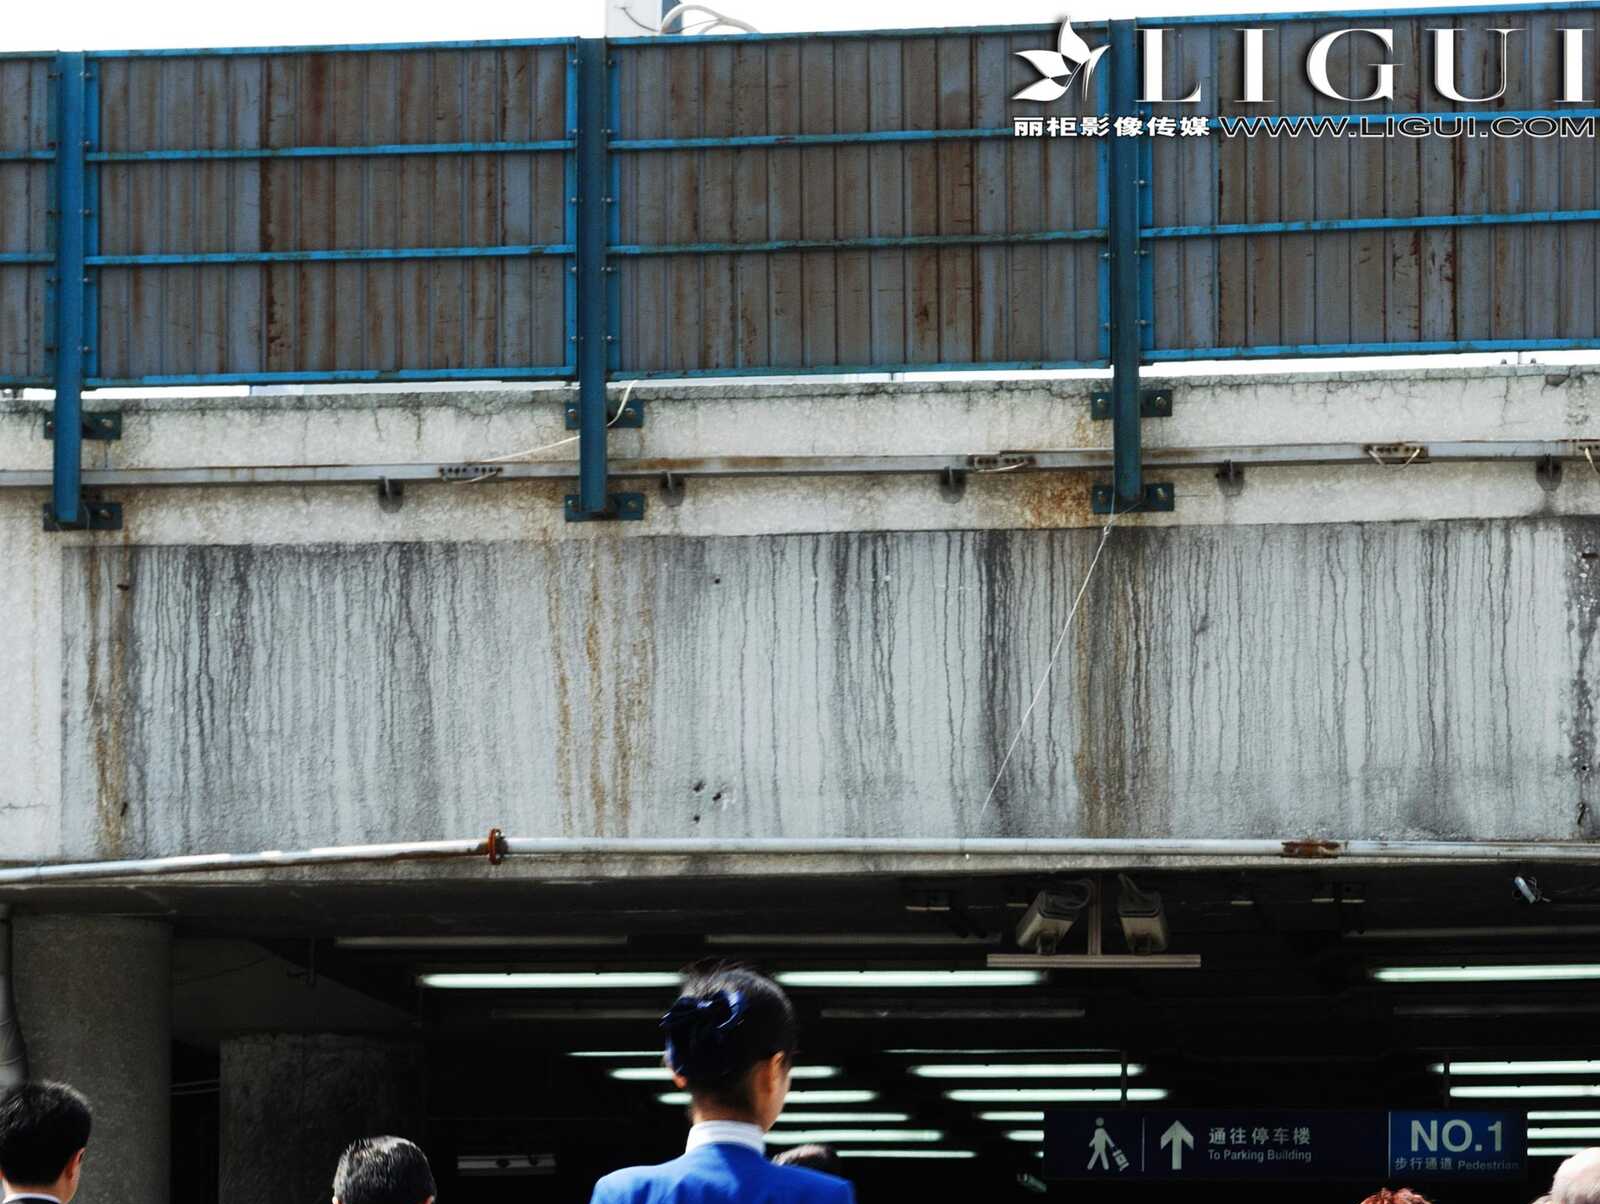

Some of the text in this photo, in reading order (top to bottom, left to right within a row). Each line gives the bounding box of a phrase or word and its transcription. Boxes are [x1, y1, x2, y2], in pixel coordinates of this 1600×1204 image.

[1208, 1127, 1311, 1145] 通往停车楼
[1410, 1118, 1503, 1153] NO.1
[1208, 1149, 1312, 1163] To Parking Building
[1394, 1156, 1453, 1170] 步行通道
